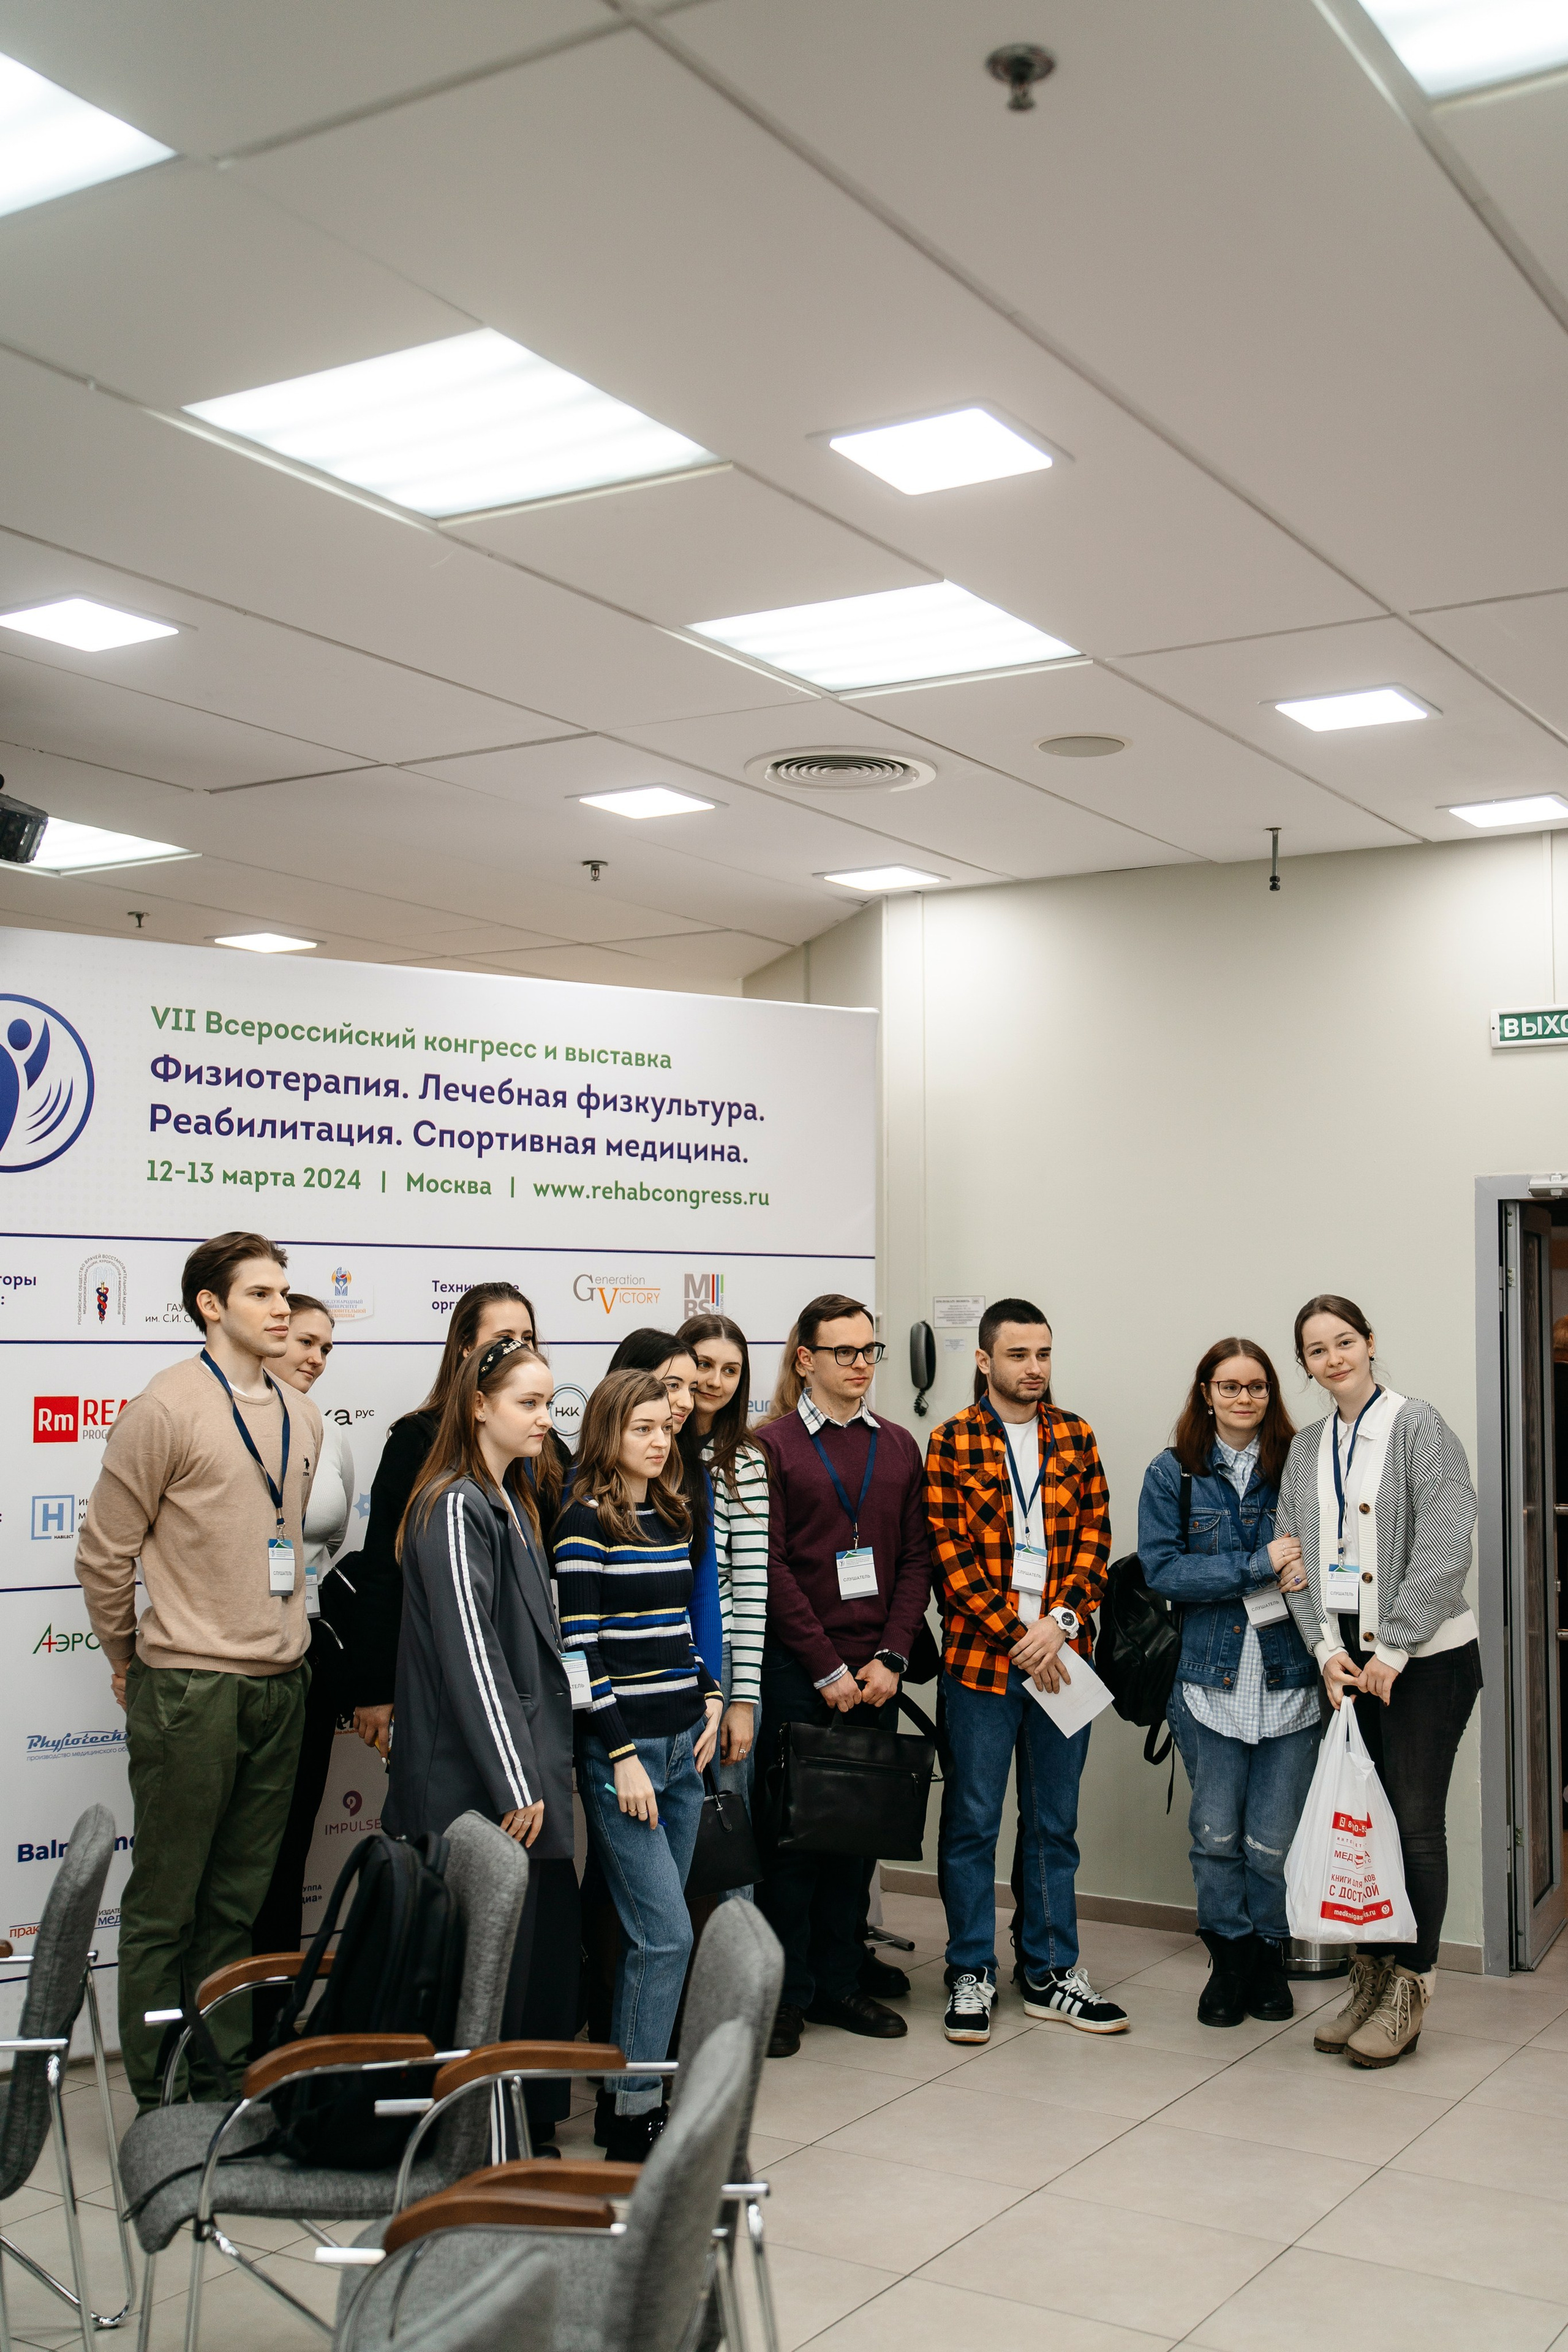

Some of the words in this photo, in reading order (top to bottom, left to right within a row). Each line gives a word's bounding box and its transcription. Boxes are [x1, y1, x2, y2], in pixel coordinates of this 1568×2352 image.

[151, 1006, 196, 1033] VII
[206, 1011, 415, 1050] Всероссийский
[424, 1036, 537, 1062] конгресс
[545, 1046, 557, 1060] и
[566, 1047, 672, 1069] выставка
[151, 1054, 409, 1102] Физиотерапия.
[418, 1073, 567, 1109] Лечебная
[577, 1084, 765, 1128] физкультура.
[150, 1103, 402, 1147] Реабилитация.
[413, 1120, 596, 1159] Спортивная
[606, 1139, 748, 1164] медицина.
[223, 1170, 296, 1193] марта
[303, 1167, 361, 1190] 2024
[407, 1172, 492, 1195] Москва
[533, 1180, 770, 1210] www.rehabcongress.ru
[38, 1408, 74, 1431] Rm
[355, 1409, 375, 1419] рус
[1017, 1569, 1042, 1578] СЛУШАТЕЛЬ
[1251, 1600, 1280, 1612] СЛУШАТЕЛЬ
[27, 1752, 71, 1762] производство
[72, 1747, 117, 1758] медицинского
[325, 1819, 381, 1836] IMPULSE
[1331, 1874, 1352, 1885] КНИГИ
[1329, 1885, 1336, 1896] С
